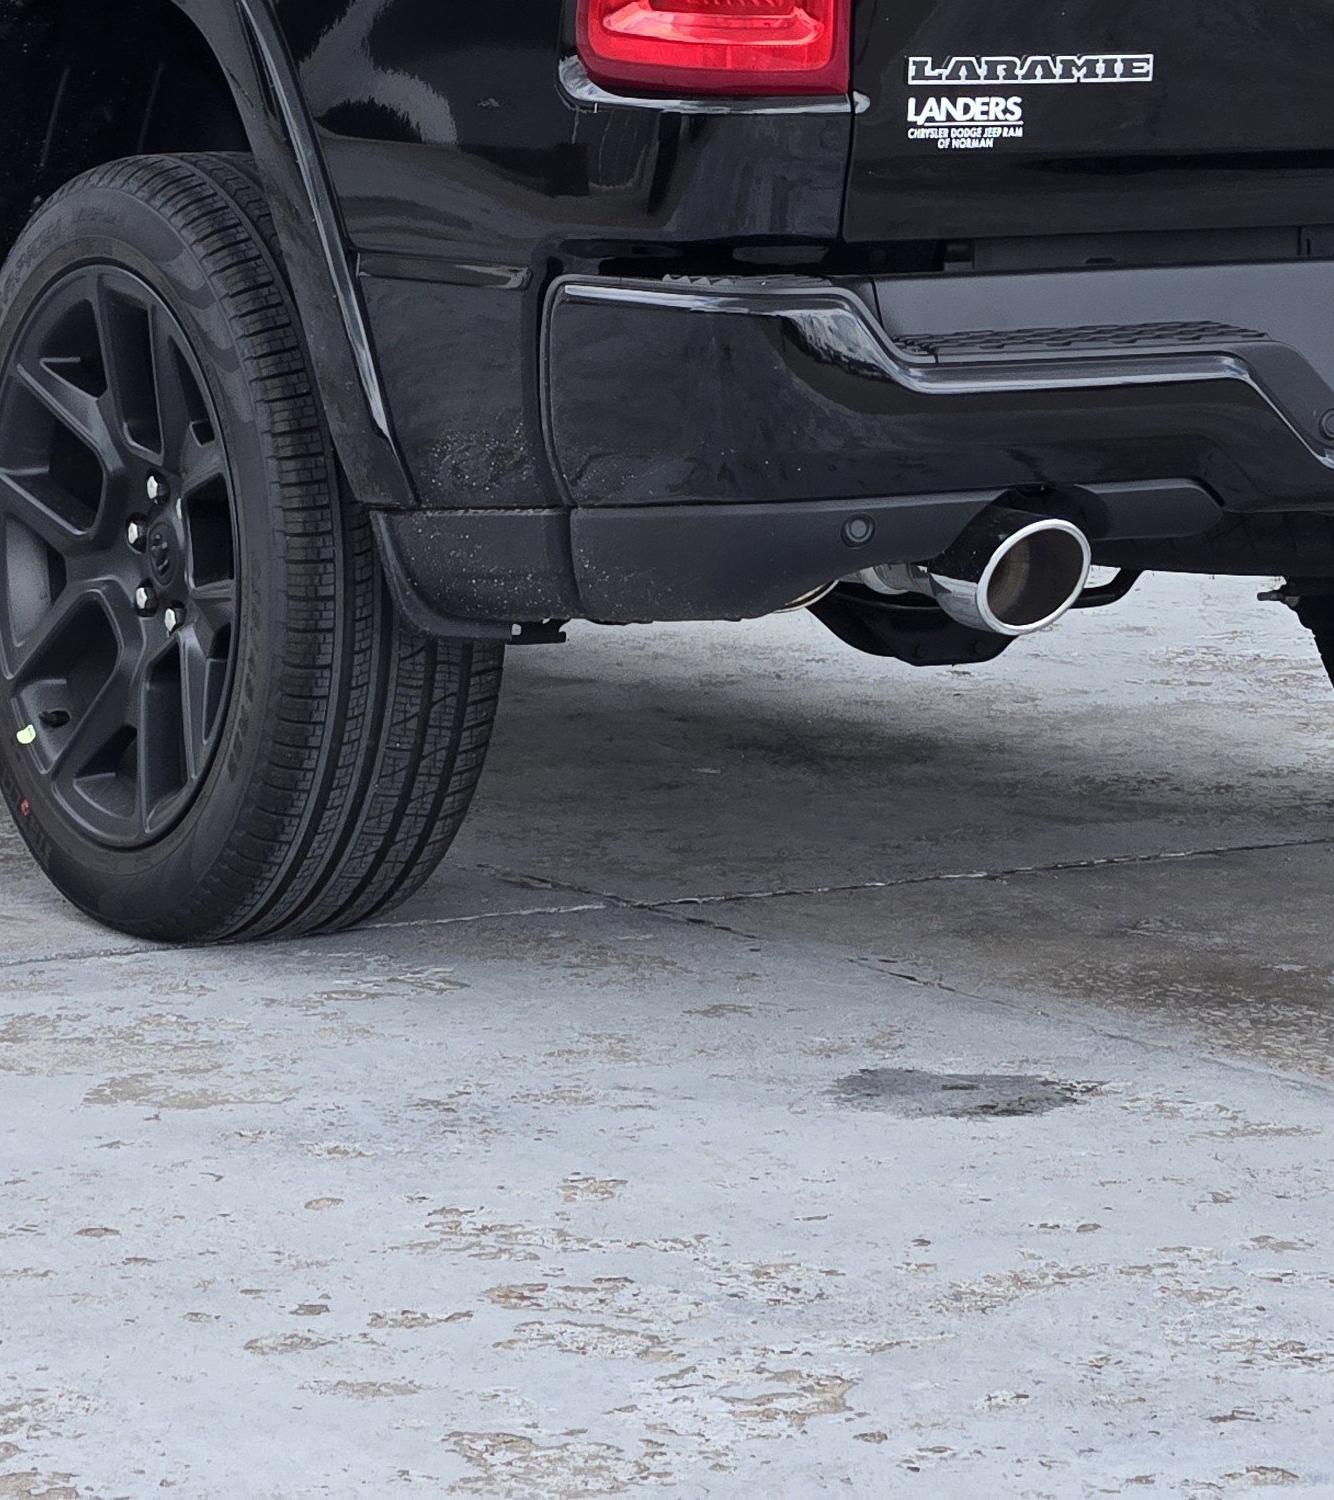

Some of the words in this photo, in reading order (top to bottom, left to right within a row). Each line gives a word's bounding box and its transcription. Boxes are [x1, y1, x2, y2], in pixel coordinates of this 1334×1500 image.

[908, 54, 1154, 85] LARAMIE
[907, 96, 1022, 125] LANDERS
[908, 128, 949, 139] CHRYSLER
[951, 127, 982, 138] DODGE
[984, 127, 1002, 138] JEEP
[1002, 127, 1023, 137] RAM
[937, 138, 950, 149] OF
[952, 138, 994, 148] NORMAN
